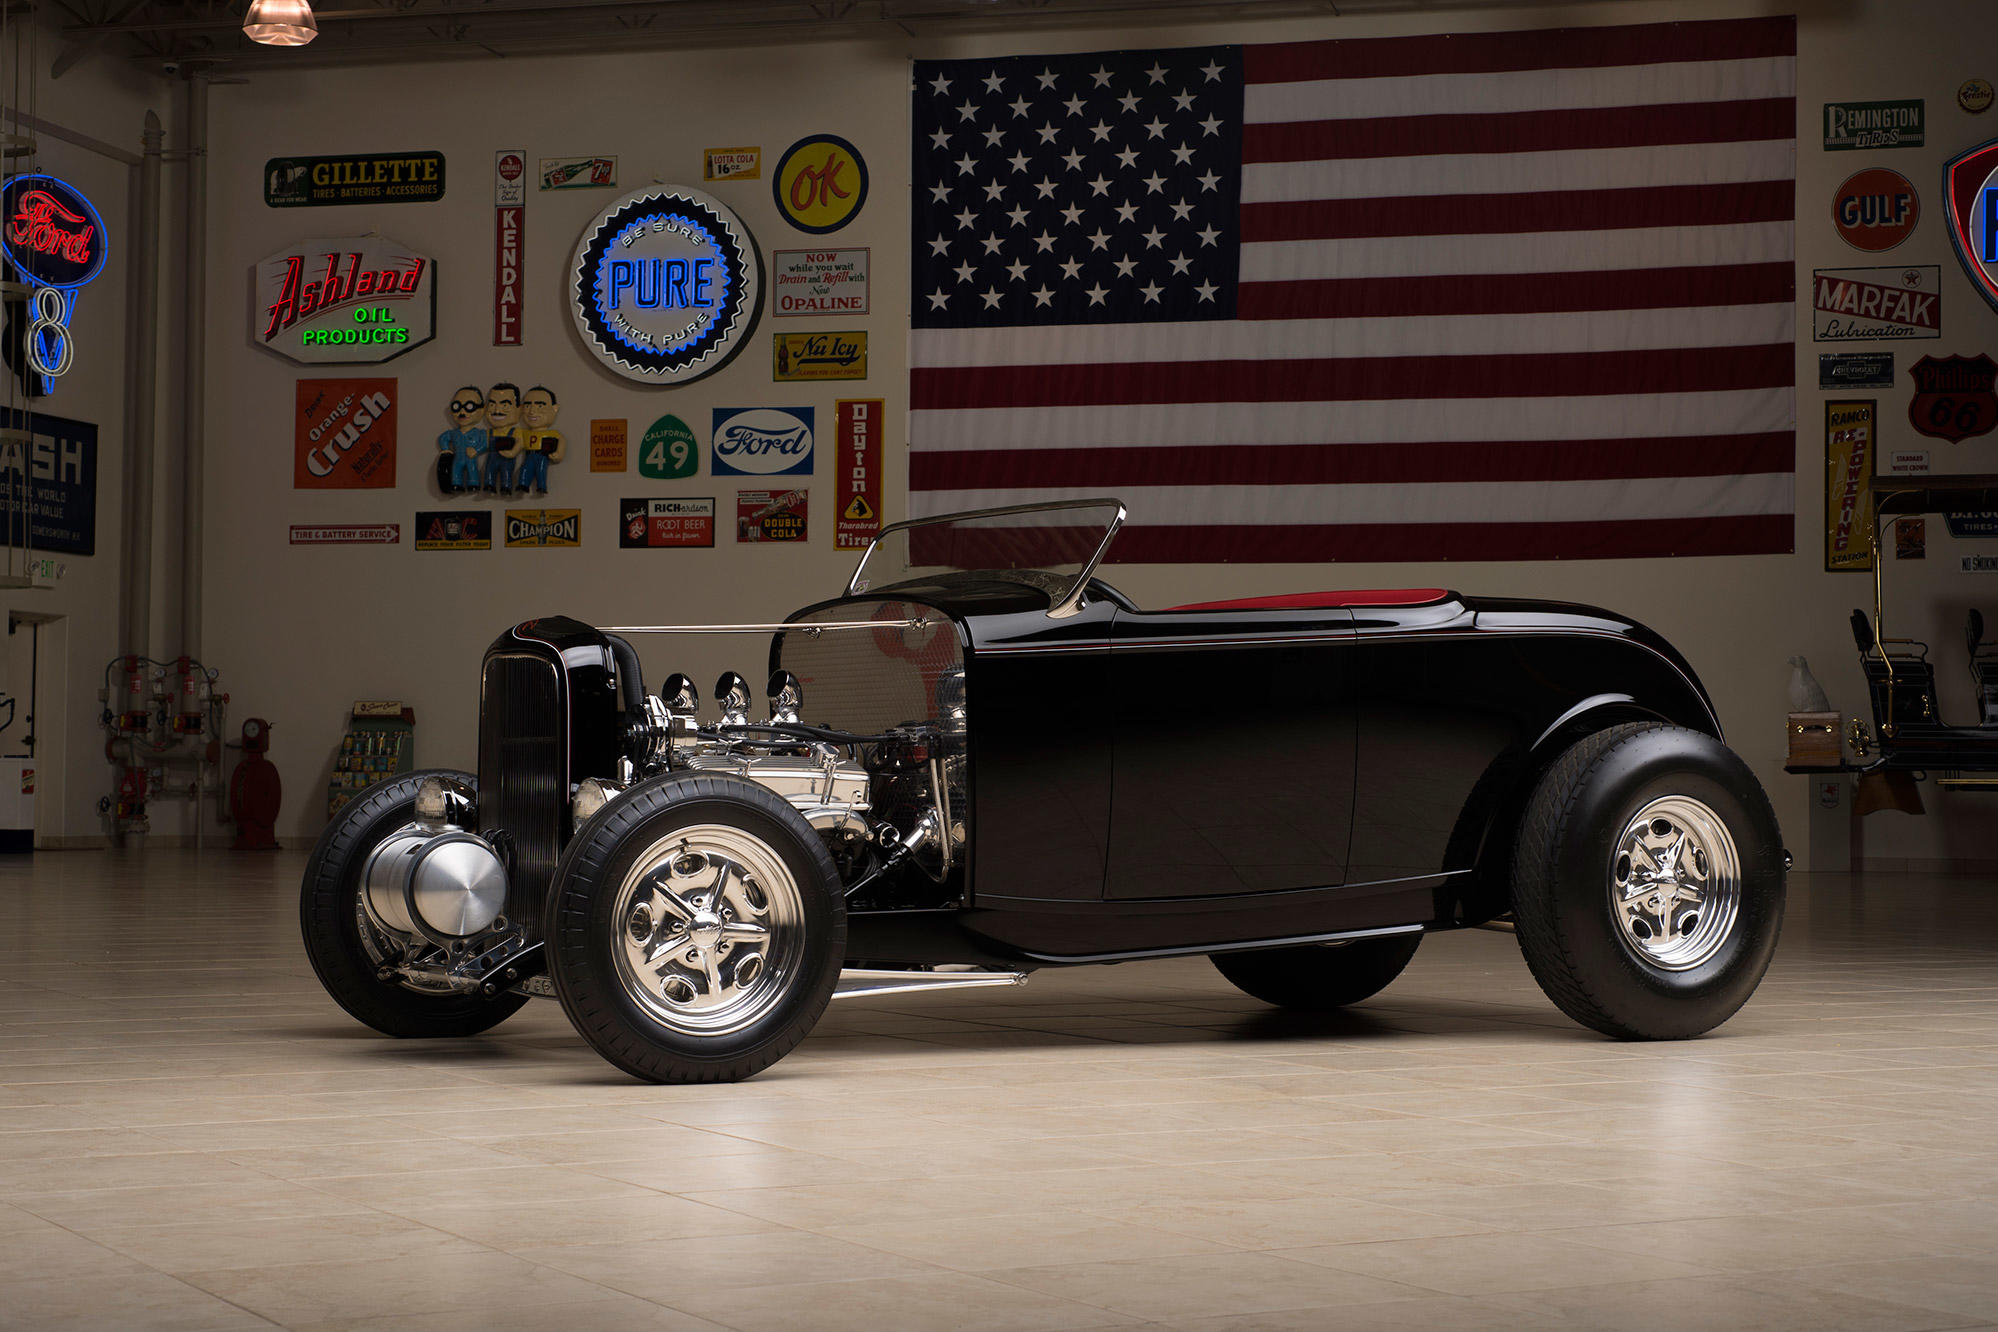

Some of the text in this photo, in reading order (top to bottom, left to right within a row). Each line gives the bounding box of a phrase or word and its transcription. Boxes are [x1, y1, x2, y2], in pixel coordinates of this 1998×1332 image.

[1828, 105, 1920, 139] REMINGTON
[714, 154, 754, 164] LOTTA COLA
[312, 158, 438, 186] GILLETTE
[718, 164, 730, 174] 16
[790, 152, 851, 211] OK
[313, 184, 437, 198] TIRES BATTERIES ACCESSORIES
[1839, 192, 1911, 229] GULF
[8, 190, 94, 263] Ford
[622, 222, 705, 247] BE SURE
[806, 253, 837, 263] NOW
[501, 210, 517, 342] KENDALL
[789, 263, 854, 274] while you wait
[608, 258, 715, 310] PURE
[778, 274, 807, 285] Drain
[822, 271, 849, 286] Refill
[848, 273, 865, 282] with
[264, 253, 426, 342] Ashland
[781, 295, 862, 311] OPALINE
[1816, 279, 1937, 327] MARFAK
[353, 307, 396, 323] OIL
[303, 327, 409, 346] PRODUCTS
[614, 312, 709, 345] WITH PURE
[1819, 319, 1916, 339] Lubrication
[793, 336, 860, 363] Nu Icy
[1831, 409, 1870, 426] RAMCO
[1930, 397, 1980, 431] 66
[307, 391, 391, 477] Crush
[593, 434, 624, 445] CHARGE
[645, 429, 694, 442] CALIFORNIA
[718, 426, 807, 455] Ford
[595, 447, 623, 457] CARDS
[645, 441, 689, 471] 49
[852, 403, 867, 493] Dayton
[37, 487, 66, 503] WORLD
[40, 503, 64, 519] VALUE
[509, 517, 575, 539] CHAMPION
[657, 520, 706, 530] ROOT BEER
[764, 518, 803, 528] DOUBLE
[1963, 523, 1993, 531] TIRES
[295, 531, 312, 539] TIRE
[322, 531, 356, 539] BATTERY
[359, 530, 391, 538] SERVICE
[771, 528, 797, 538] COLA
[1831, 551, 1868, 564] STATION
[1961, 557, 1971, 571] NO
[41, 560, 54, 578] EXIT
